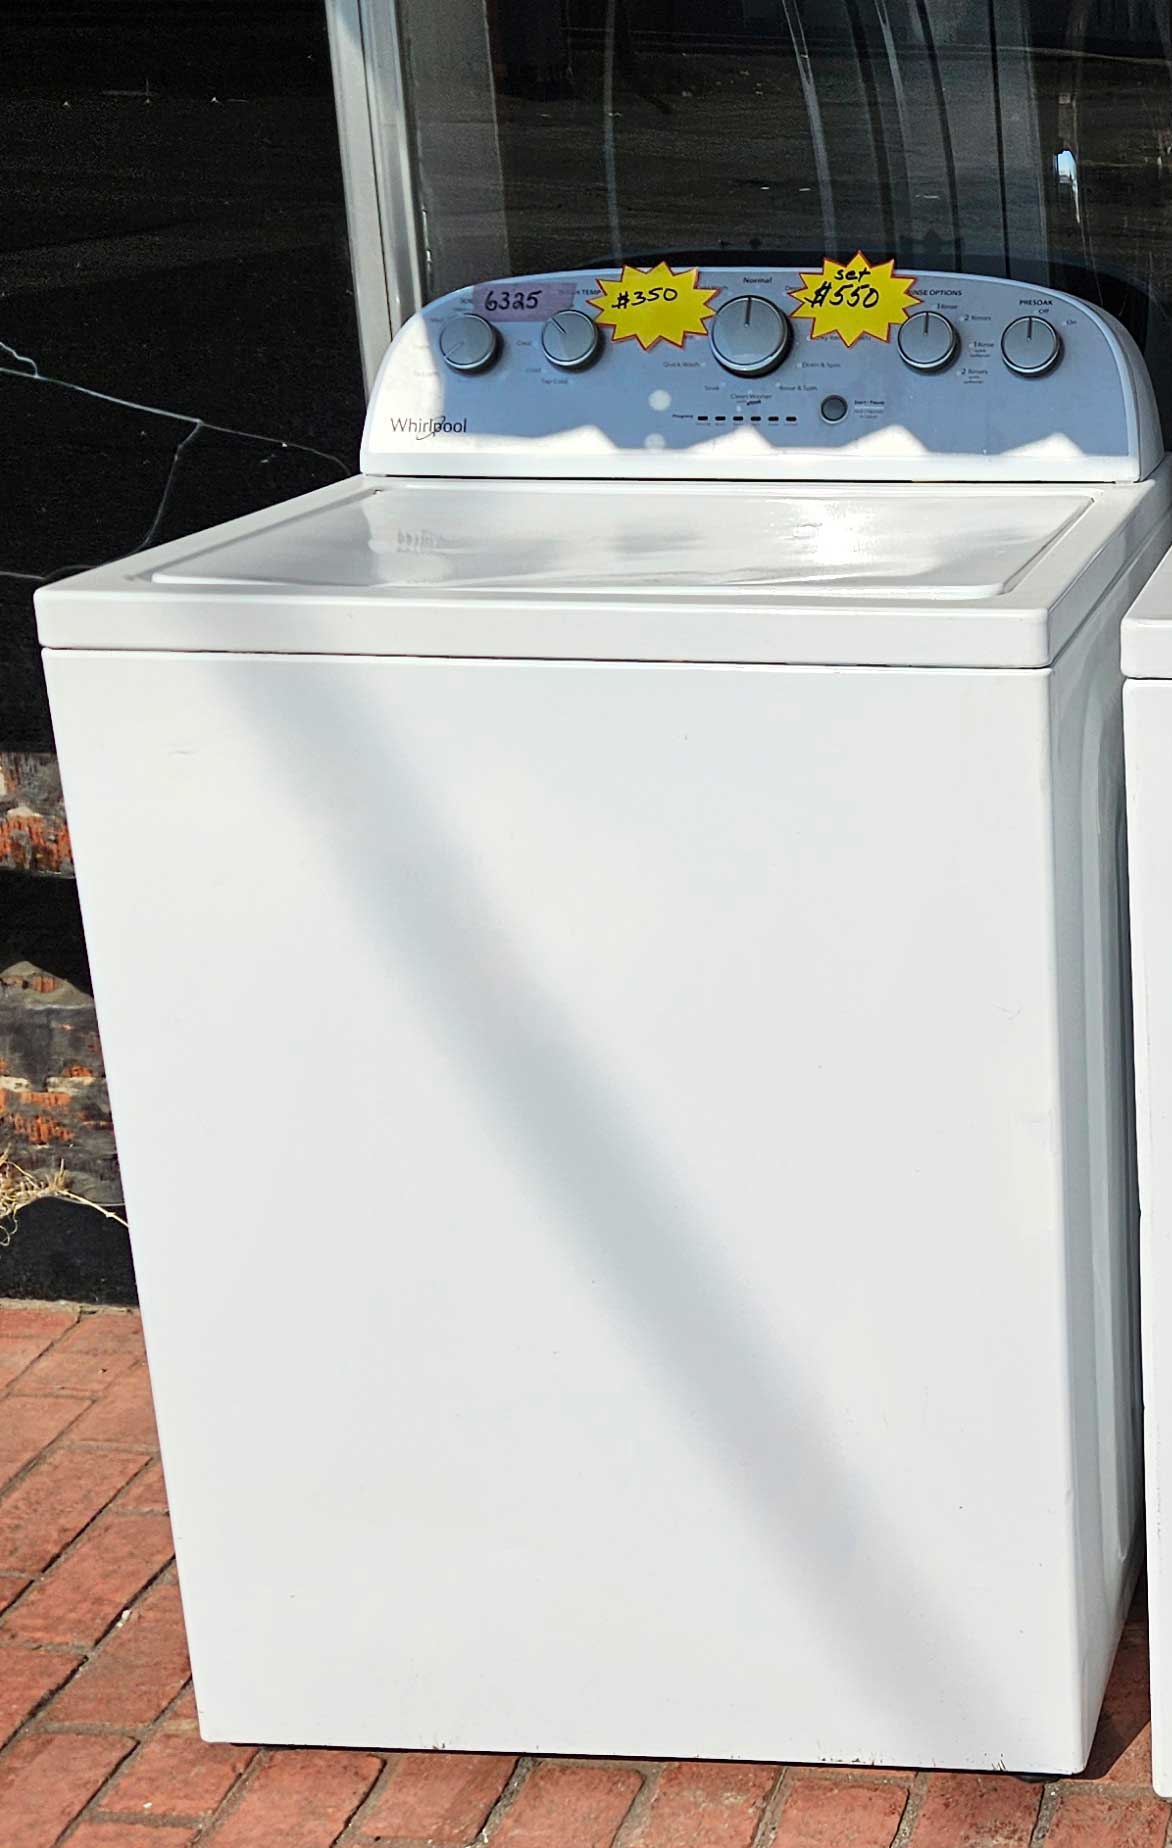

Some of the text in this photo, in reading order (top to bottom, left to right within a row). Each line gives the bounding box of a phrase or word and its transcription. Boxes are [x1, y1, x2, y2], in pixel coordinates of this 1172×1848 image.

[834, 267, 871, 282] set
[484, 290, 543, 312] 6325
[804, 281, 879, 308] $550
[929, 289, 962, 297] OPTIONS
[390, 417, 467, 438] Whirlpool
